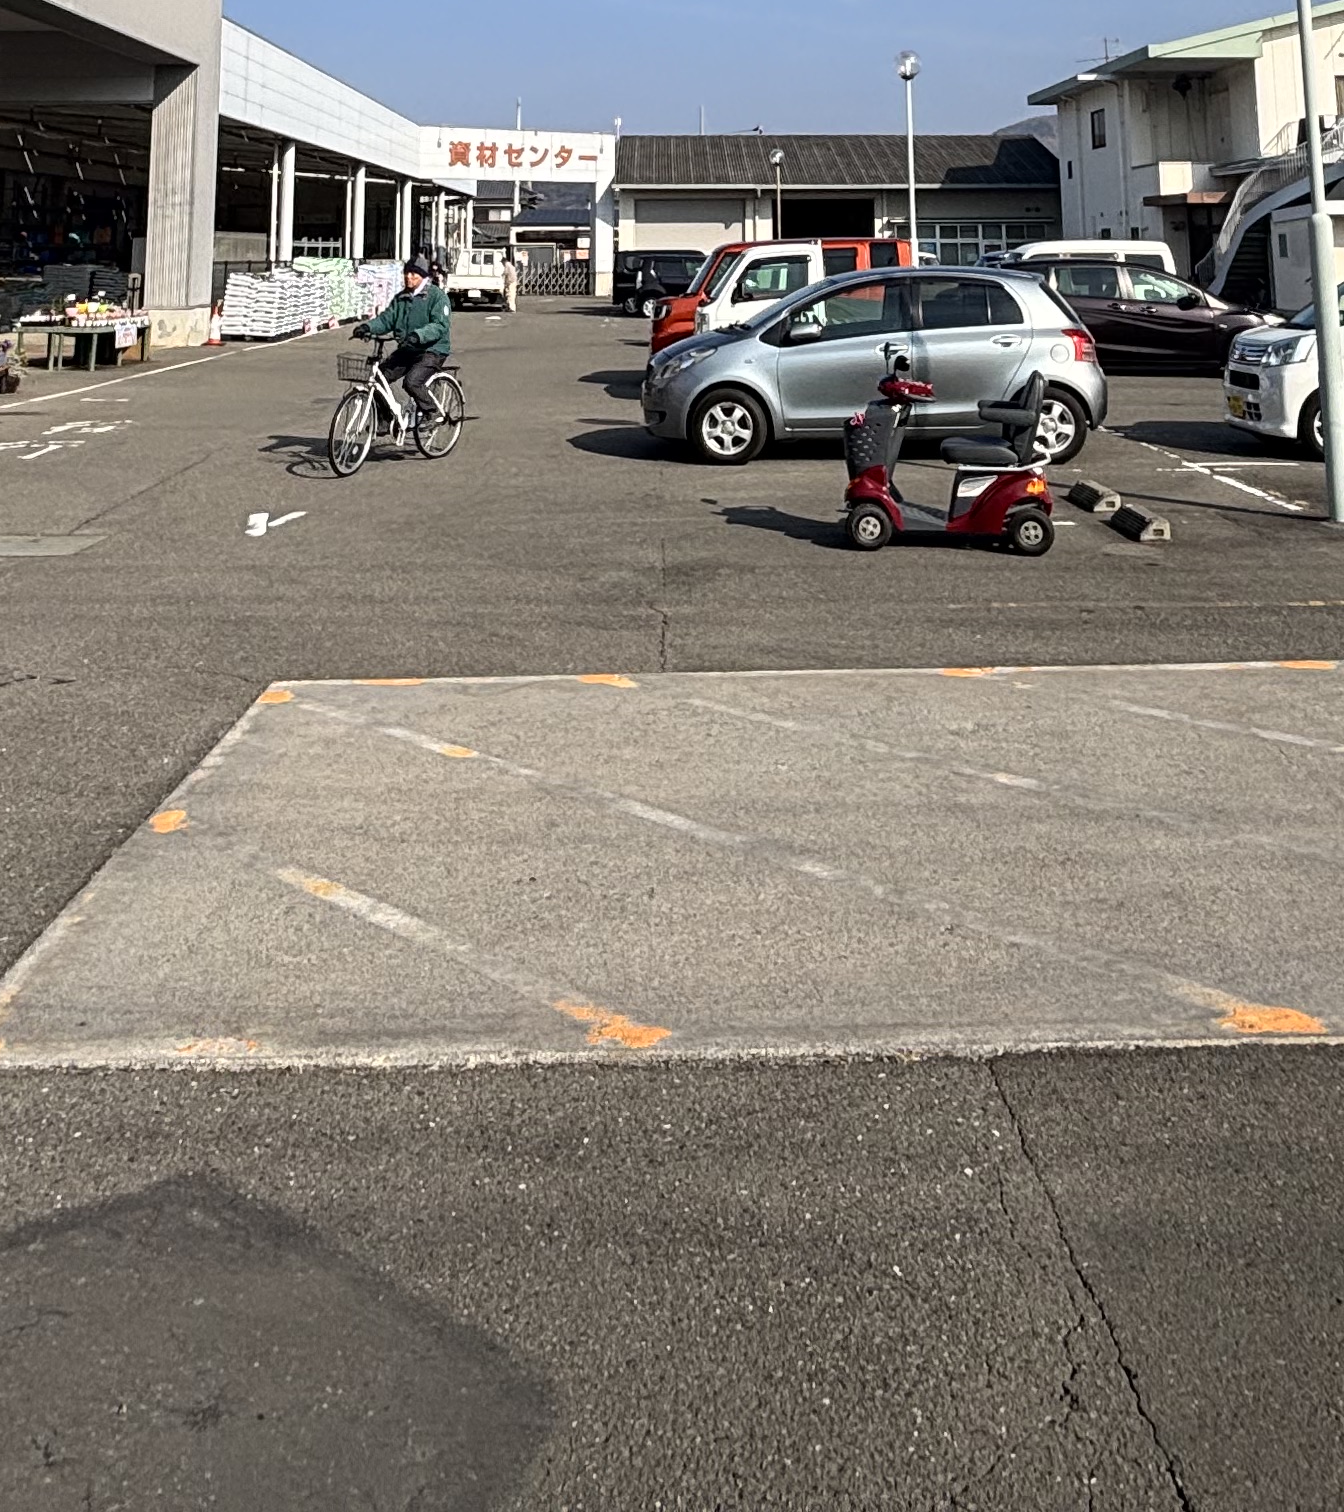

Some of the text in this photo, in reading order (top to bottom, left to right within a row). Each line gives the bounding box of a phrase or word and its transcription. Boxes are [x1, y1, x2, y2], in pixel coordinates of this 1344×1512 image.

[449, 141, 598, 168] 資材センター
